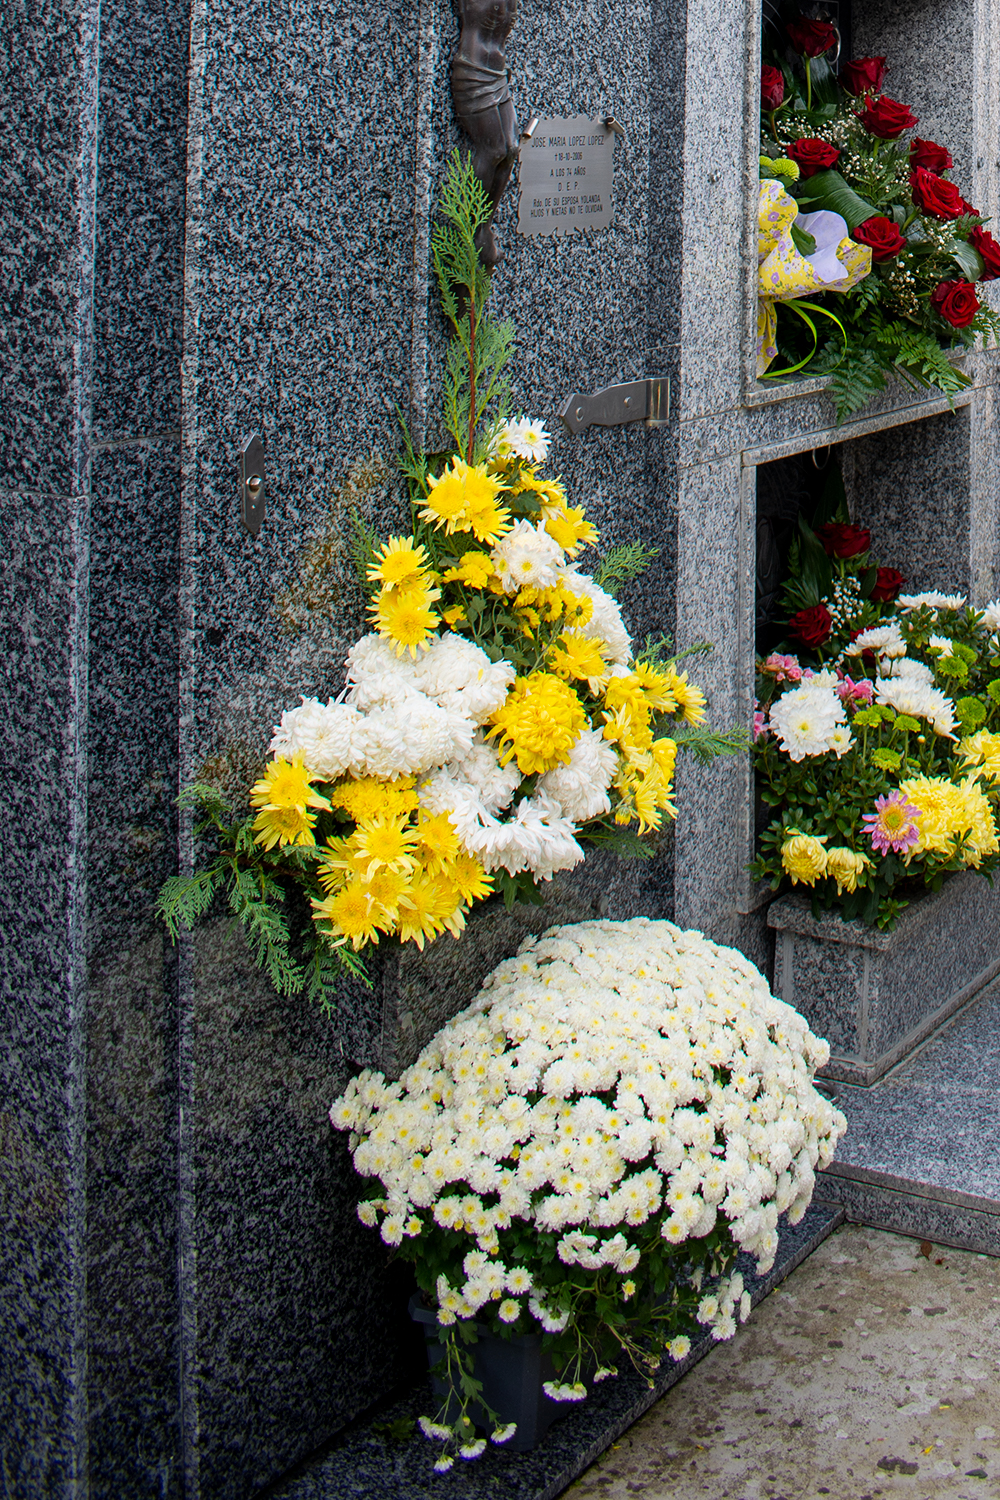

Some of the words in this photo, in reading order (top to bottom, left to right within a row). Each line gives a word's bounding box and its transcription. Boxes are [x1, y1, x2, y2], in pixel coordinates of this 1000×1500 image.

[531, 137, 546, 148] JOSE
[548, 136, 566, 147] MARIA
[569, 135, 586, 146] LOPEZ
[588, 135, 605, 146] LOPEZ
[549, 169, 555, 177] A
[556, 168, 565, 177] LOS
[573, 165, 587, 176] AÑOS
[544, 198, 552, 207] DE
[553, 197, 560, 206] SU
[561, 196, 579, 206] ESPOSA
[569, 206, 576, 215] NO
[578, 205, 584, 214] TE
